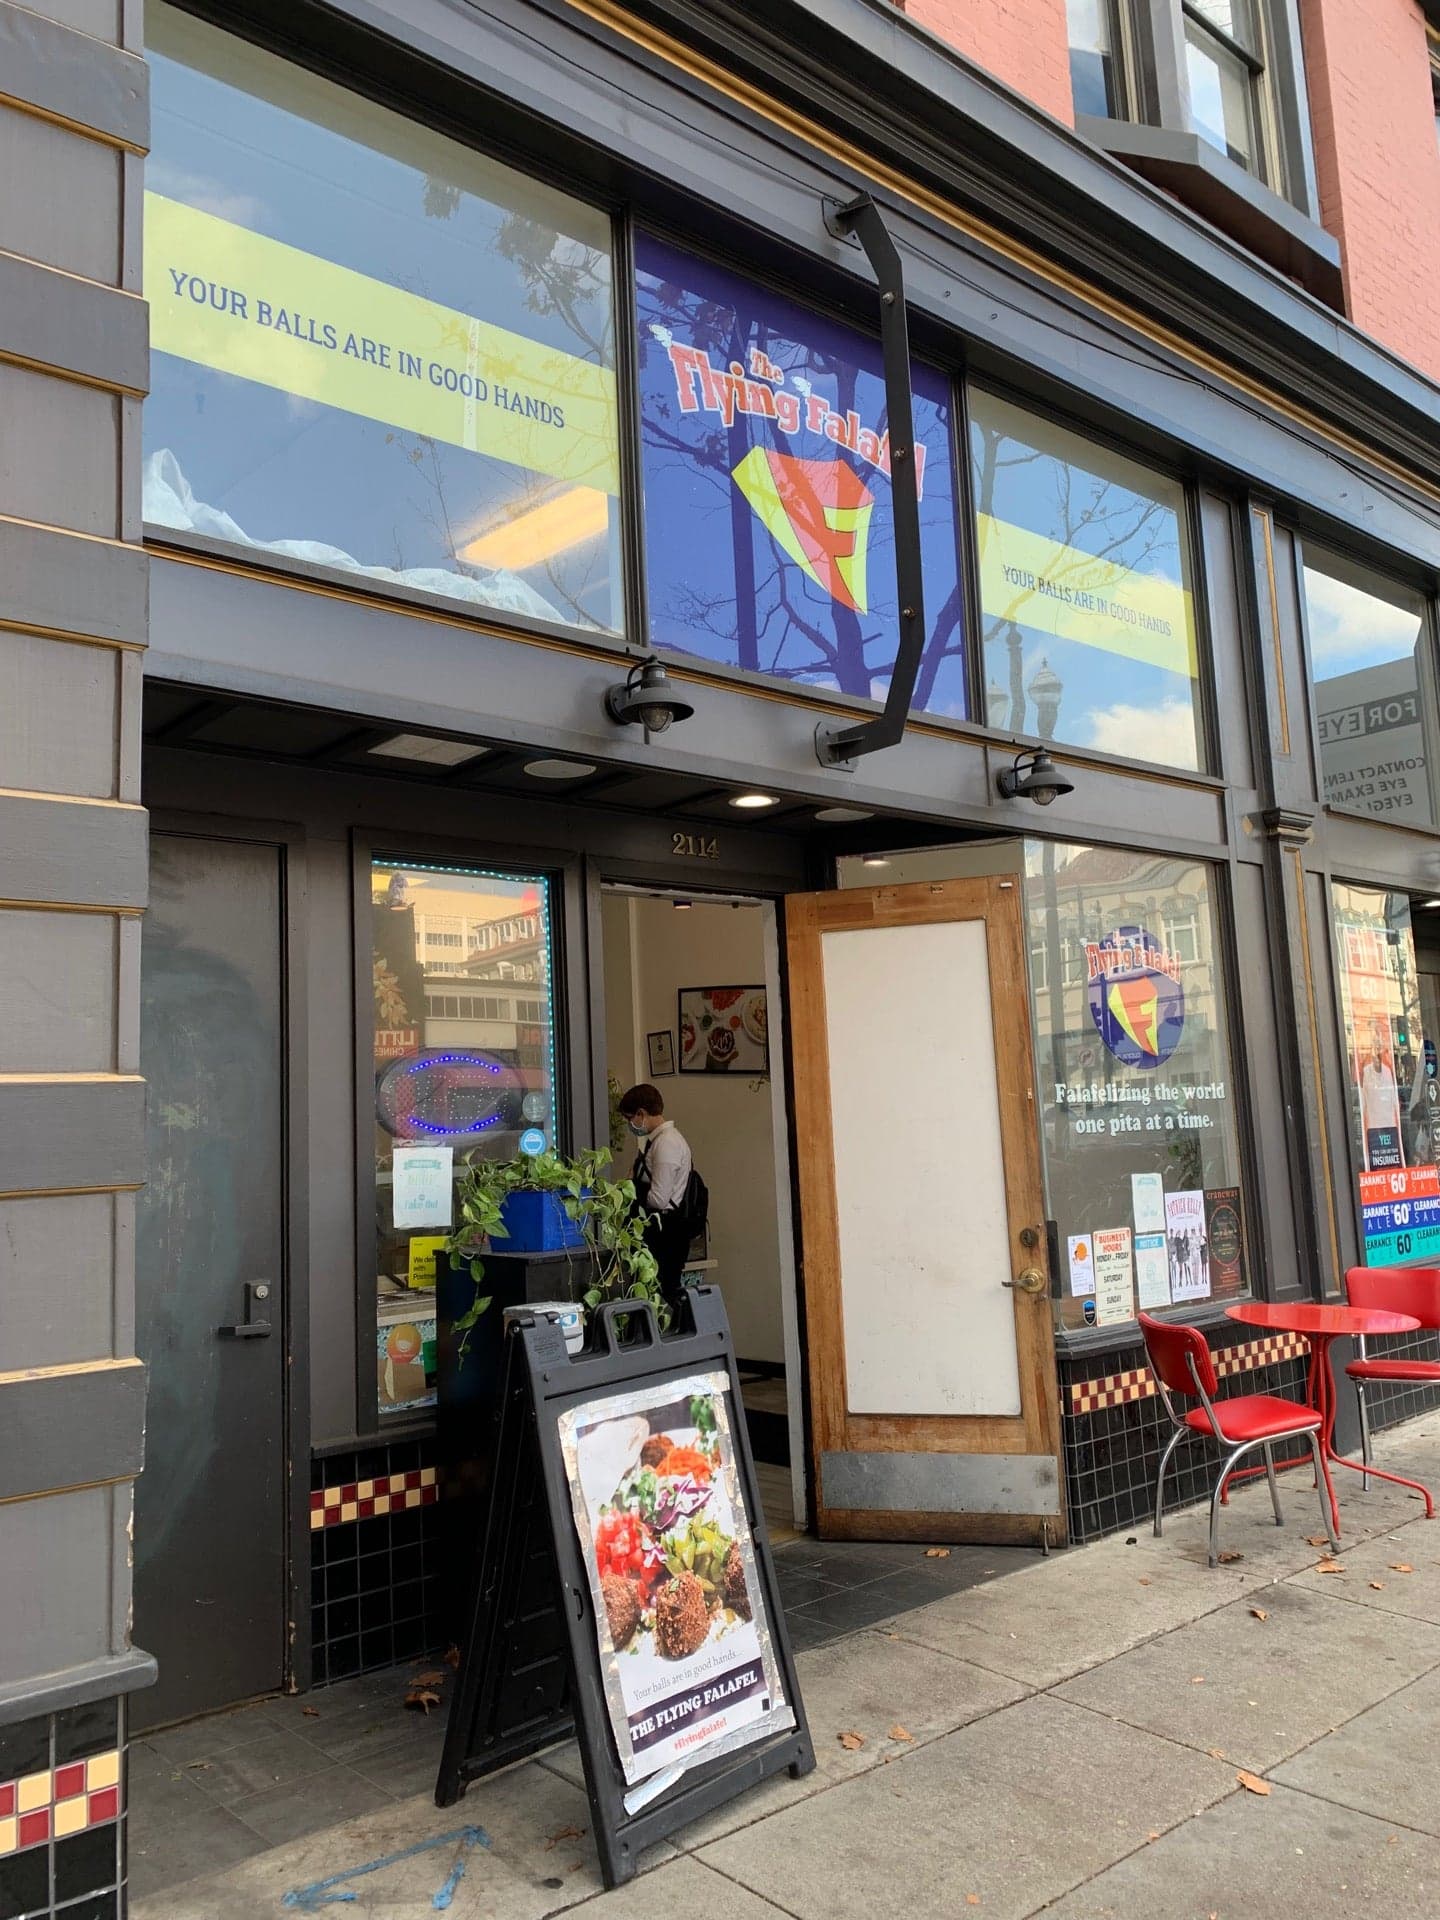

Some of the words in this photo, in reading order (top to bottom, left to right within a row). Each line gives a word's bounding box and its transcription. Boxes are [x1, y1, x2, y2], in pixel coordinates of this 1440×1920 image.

[168, 267, 248, 320] YOUR
[256, 299, 338, 350] BALLS
[342, 332, 391, 369] ARE
[398, 350, 422, 379] IN
[428, 362, 488, 401] GOOD
[494, 384, 565, 428] HANDS
[750, 347, 784, 385] The
[667, 340, 800, 434] Flying
[1003, 564, 1036, 591] YOUR
[1038, 577, 1072, 604] BALLS
[1074, 591, 1095, 611] ARE
[1097, 597, 1108, 614] IN
[1110, 602, 1137, 625] GOOD
[1138, 612, 1172, 637] HANDS
[672, 832, 719, 858] 2114
[1085, 942, 1133, 980] Flying
[1134, 943, 1181, 985] Falafel
[1055, 1083, 1151, 1105] Falafelizing
[1154, 1084, 1178, 1101] the
[1183, 1082, 1226, 1100] world
[1075, 1117, 1106, 1134] one
[1110, 1114, 1141, 1136] pita
[1145, 1114, 1162, 1131] at
[1165, 1116, 1174, 1129] a
[1178, 1111, 1214, 1129] time.
[1372, 1154, 1400, 1166] INSURANCE
[1391, 1172, 1406, 1194] 60
[1394, 1203, 1409, 1226] 60
[1397, 1233, 1411, 1255] 60
[633, 1685, 651, 1701] Your
[652, 1675, 671, 1693] balls
[671, 1673, 683, 1684] are
[683, 1670, 692, 1680] in
[693, 1660, 712, 1678] good
[630, 1717, 656, 1741] THE
[655, 1694, 702, 1729] FLYING
[703, 1670, 758, 1706] FALAFEL
